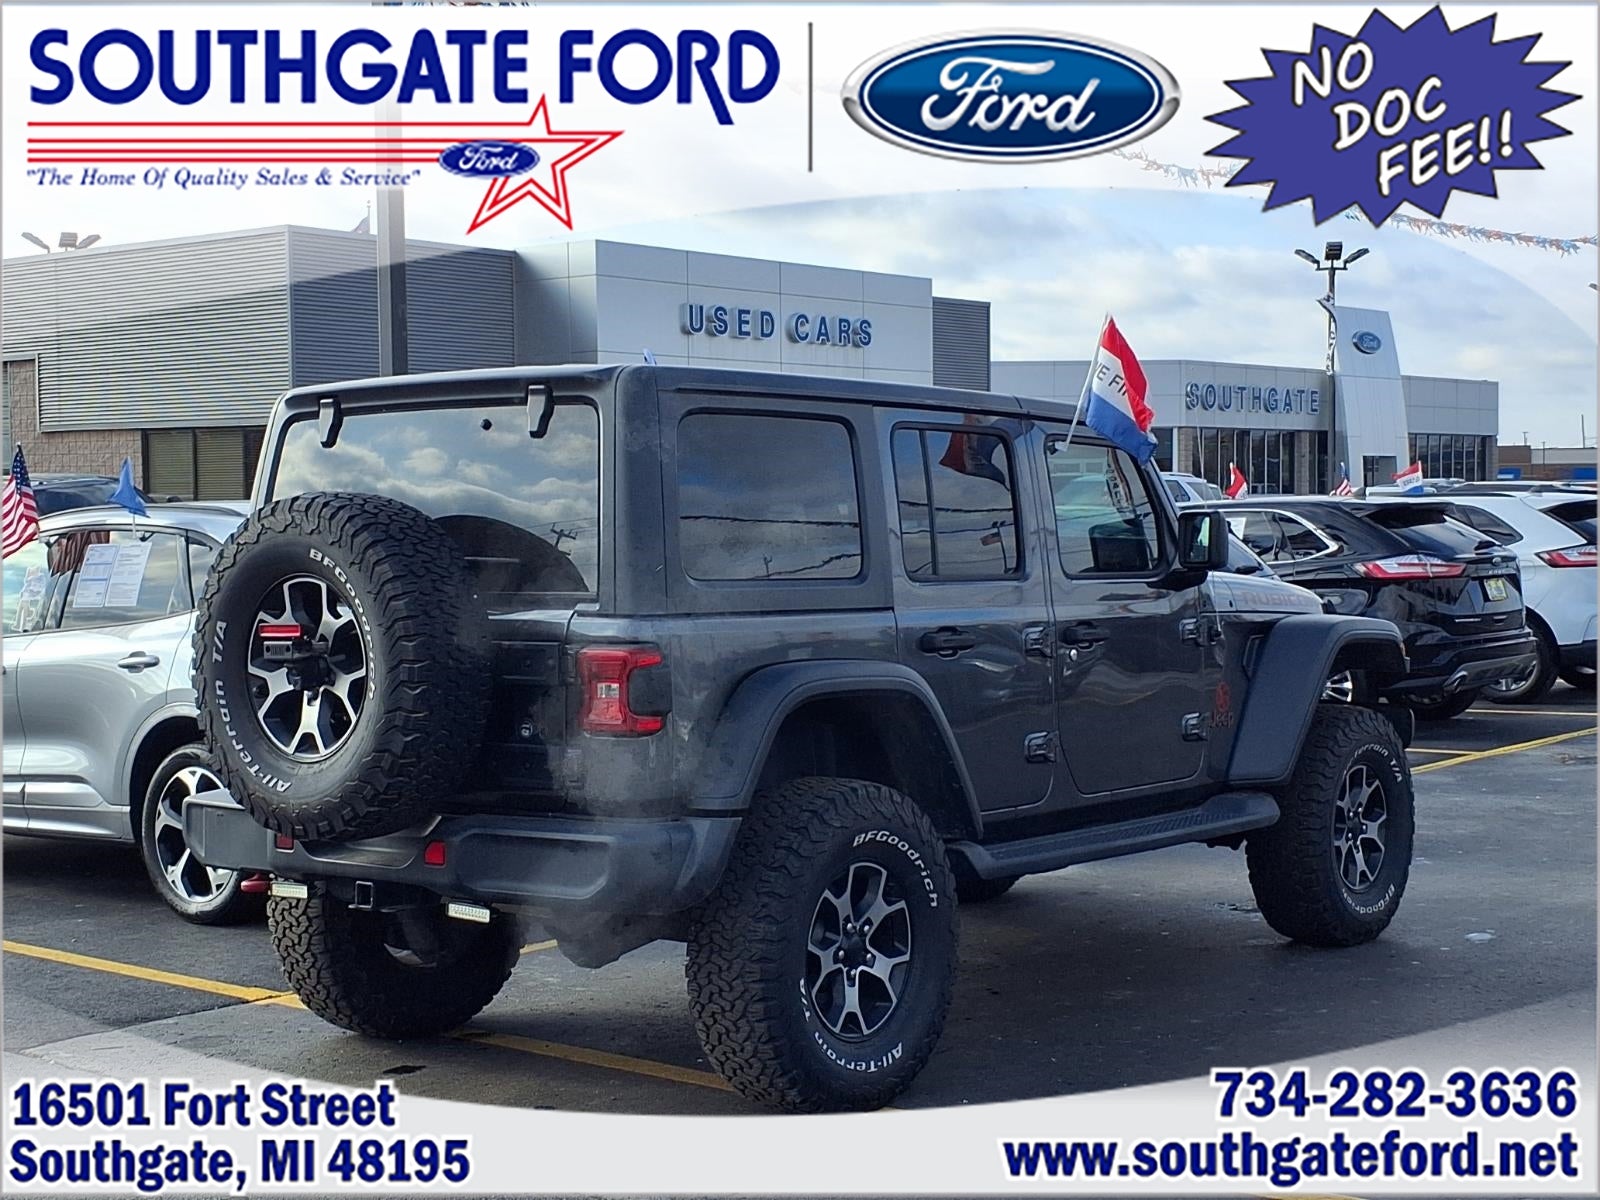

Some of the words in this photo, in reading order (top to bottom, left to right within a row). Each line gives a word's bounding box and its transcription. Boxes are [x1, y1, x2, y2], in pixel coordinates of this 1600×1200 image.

[682, 303, 775, 340] USED
[786, 312, 872, 348] CARS
[1186, 382, 1320, 415] SOUTHGATE
[212, 620, 228, 664] T/A
[309, 547, 378, 700] BFGoodrich
[214, 681, 292, 793] All-Terrain
[852, 829, 938, 908] BFGoodrich
[813, 1031, 903, 1074] All-Terrain
